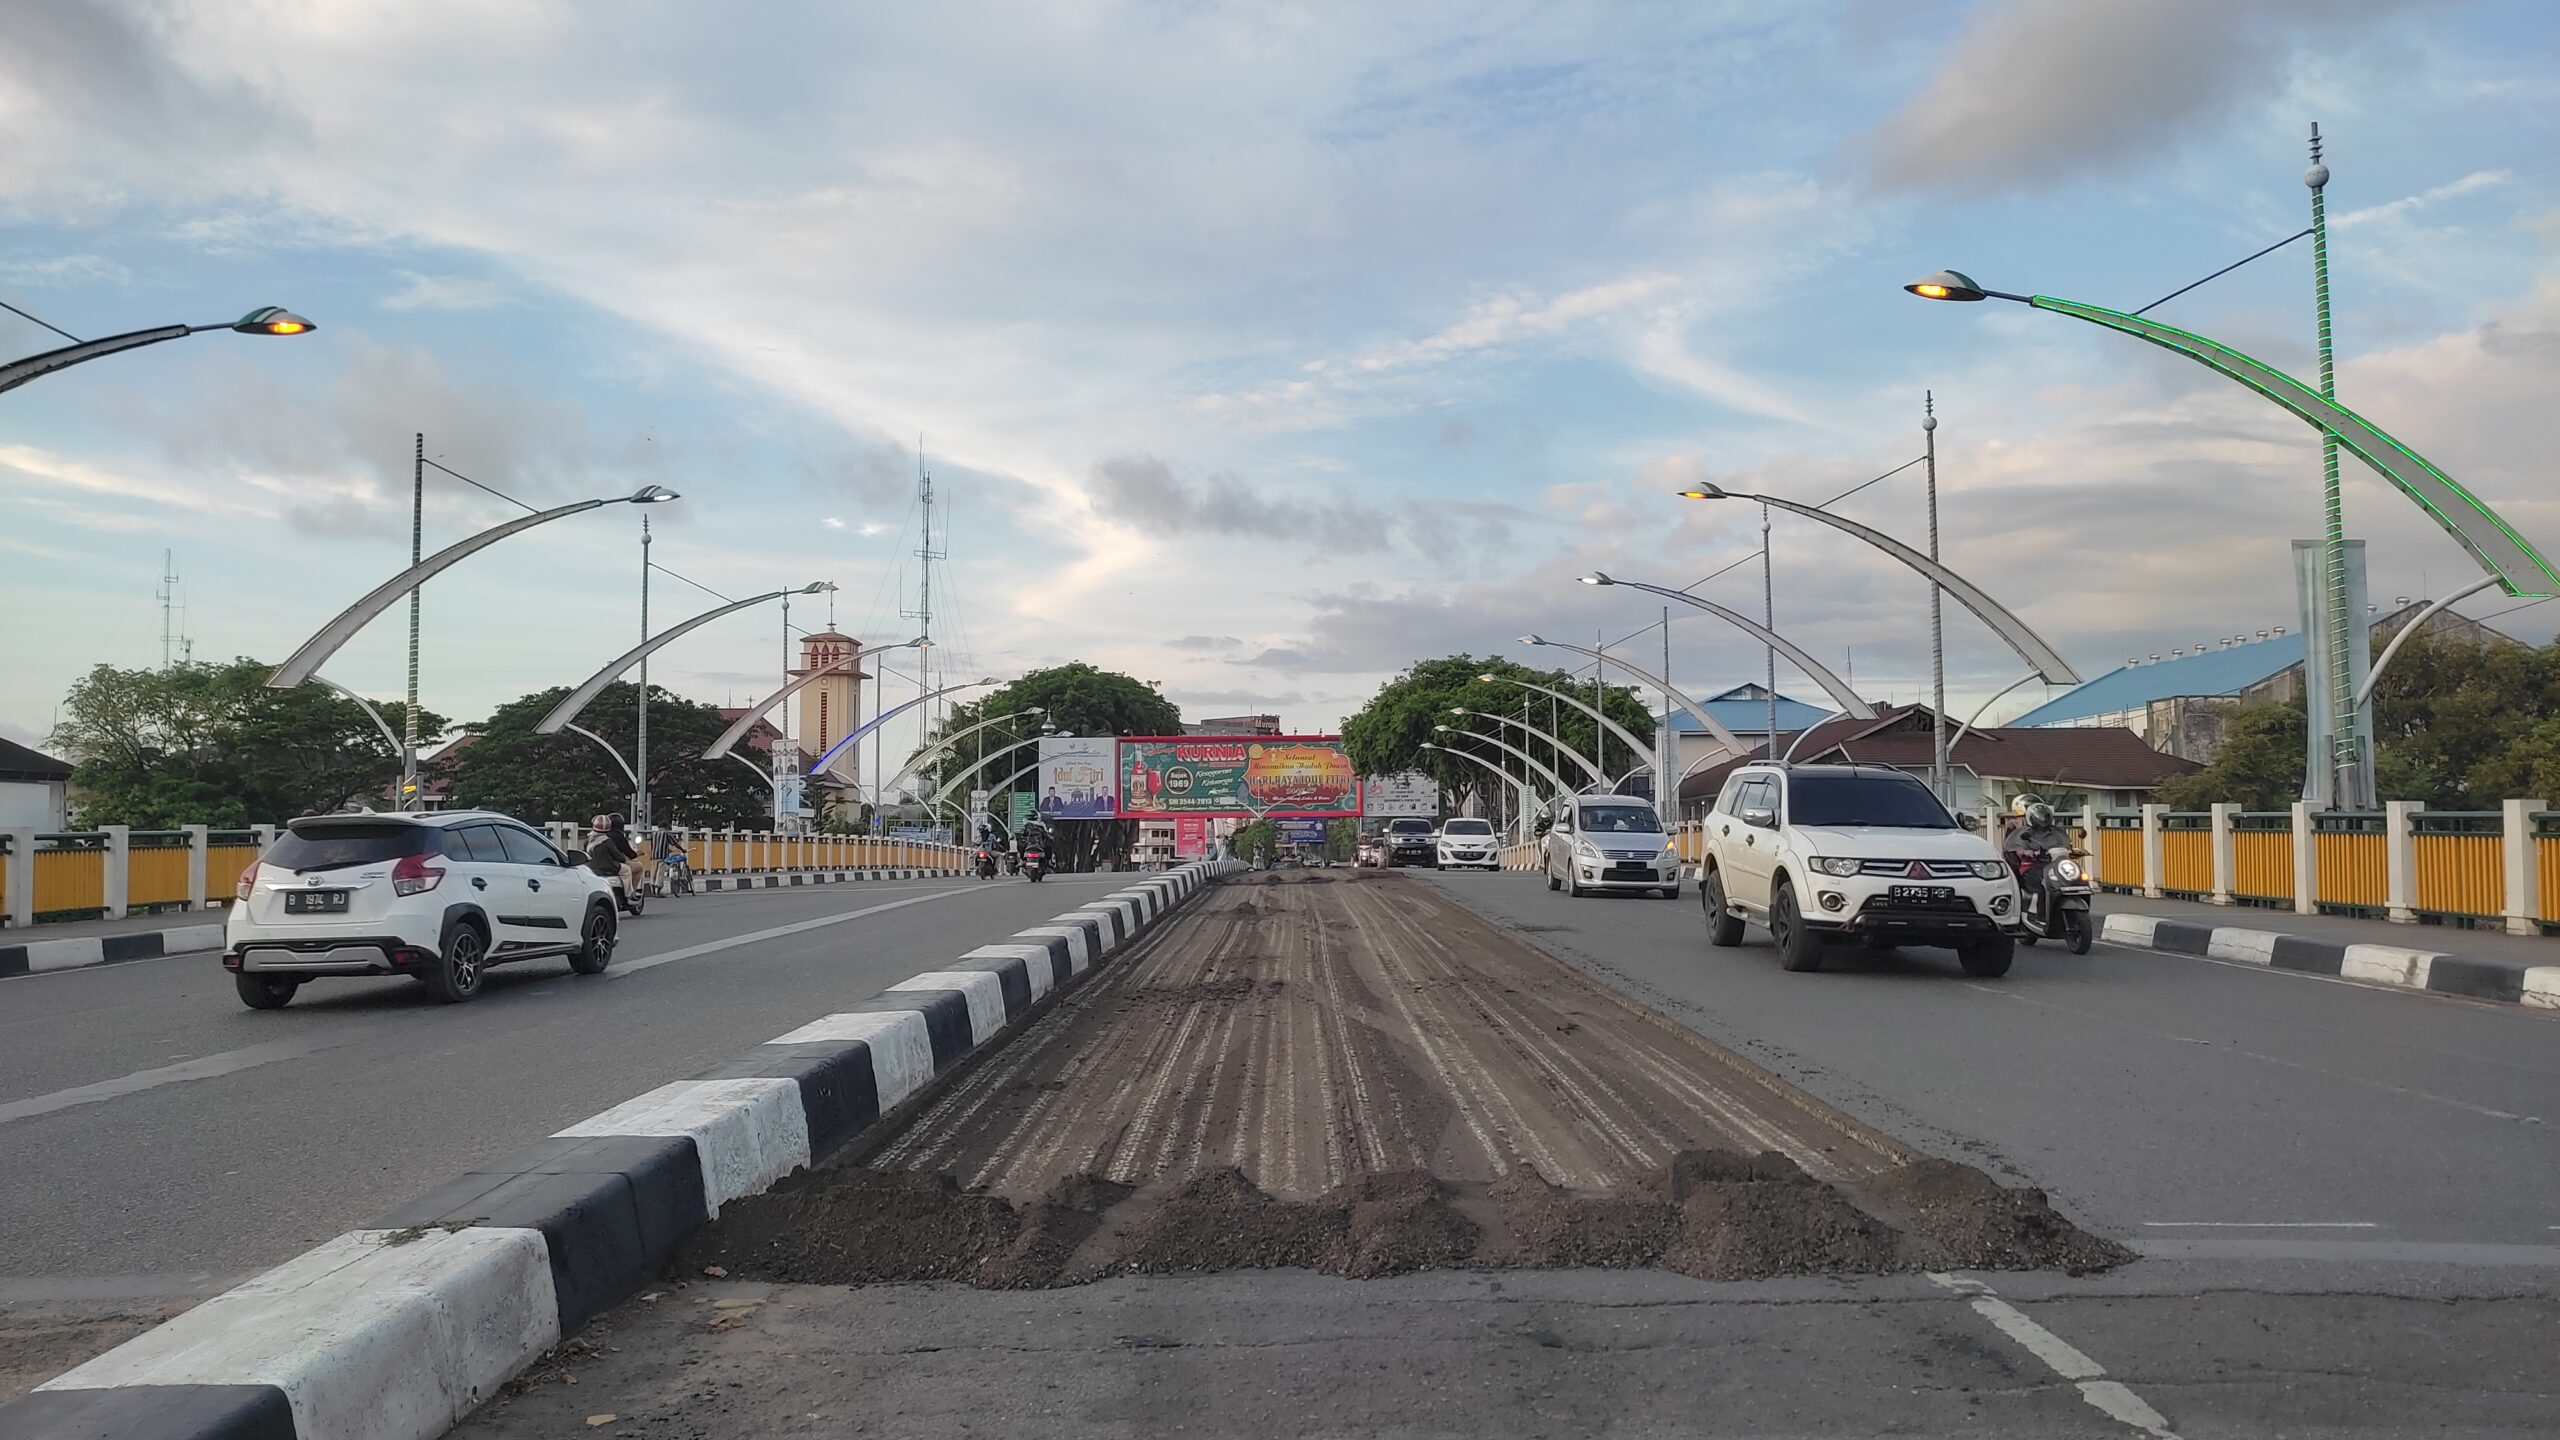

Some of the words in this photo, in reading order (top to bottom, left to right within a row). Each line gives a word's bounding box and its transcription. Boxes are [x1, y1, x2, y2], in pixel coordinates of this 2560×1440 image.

[1176, 744, 1246, 761] KURNIA
[1275, 775, 1299, 785] RAYA
[1326, 775, 1350, 785] FITRI
[289, 894, 296, 905] B
[332, 893, 345, 905] RJ
